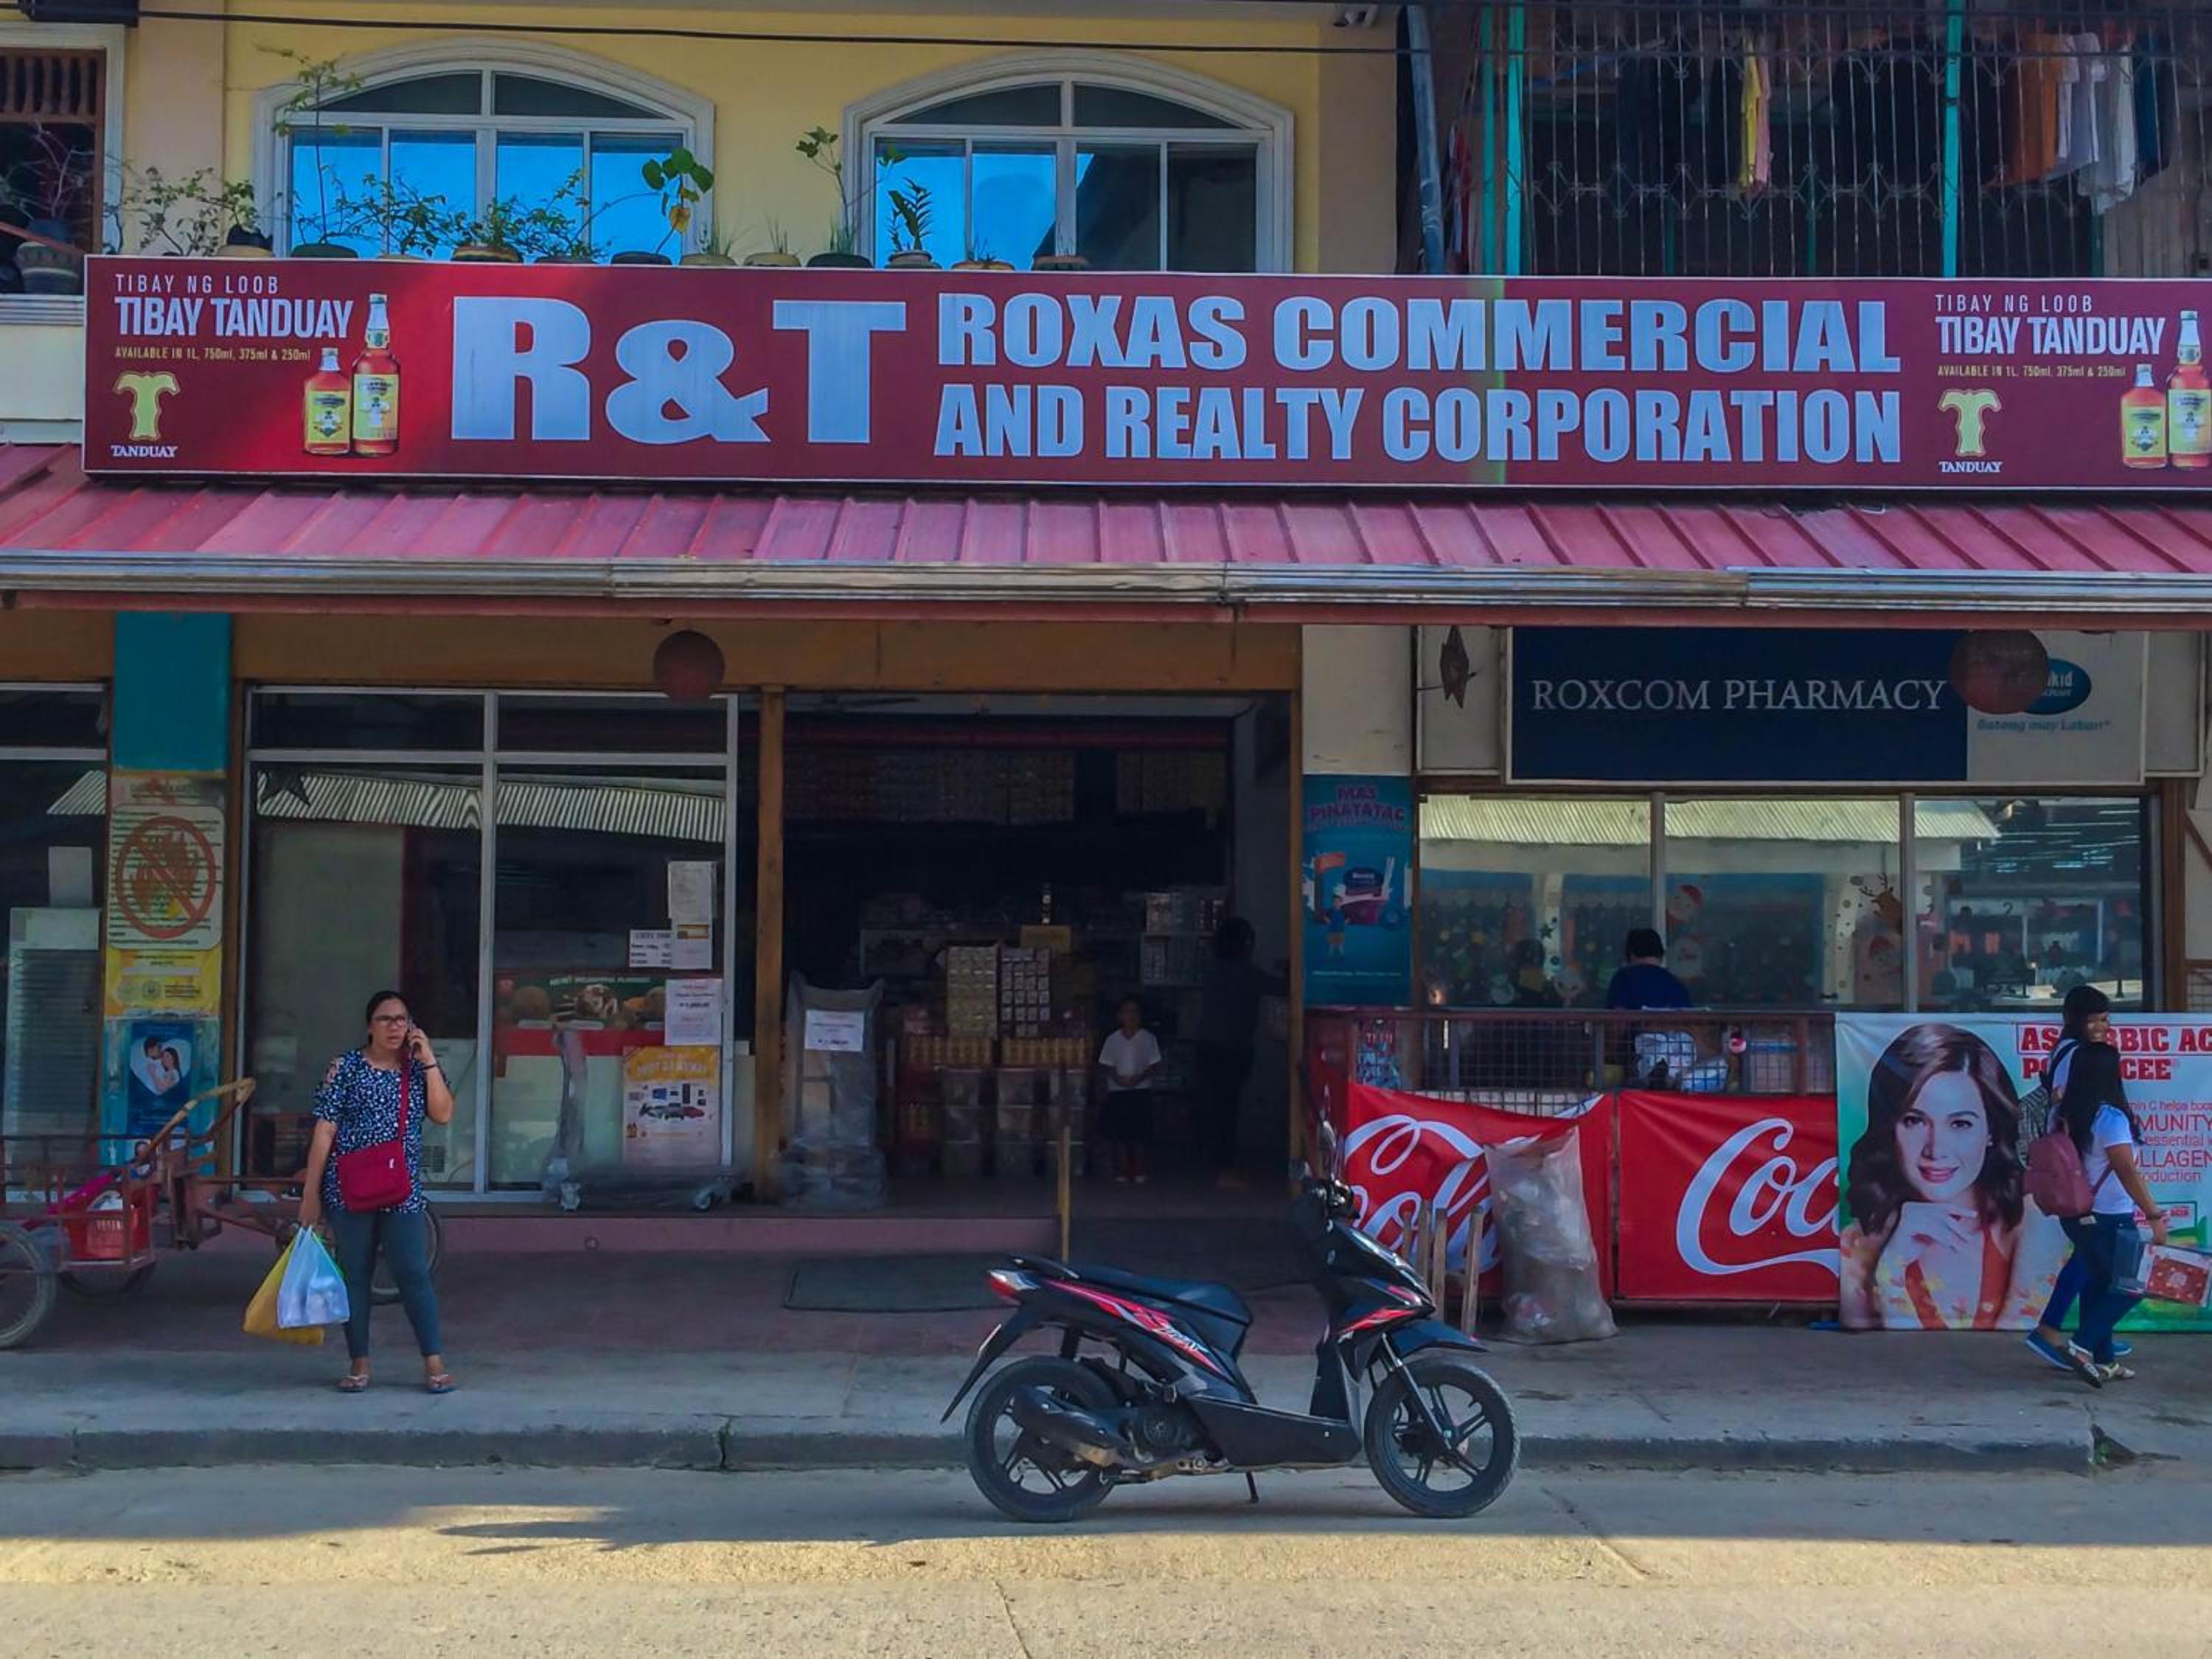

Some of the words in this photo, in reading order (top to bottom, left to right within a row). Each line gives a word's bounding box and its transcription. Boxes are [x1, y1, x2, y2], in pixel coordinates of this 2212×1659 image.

[115, 274, 175, 293] TIBAY
[187, 275, 213, 294] NG
[225, 275, 279, 294] LOOB
[1935, 294, 1992, 313] TIBAY
[2005, 295, 2029, 313] NG
[2042, 295, 2093, 313] LOOB
[114, 296, 203, 337] TIBAY
[211, 297, 354, 338] TANDUAY
[939, 293, 1247, 370] ROXAS
[1273, 295, 1902, 374] COMMERCIAL
[1935, 316, 2020, 354] TIBAY
[2027, 316, 2166, 355] TANDUAY
[115, 347, 168, 359] AVAILABLE
[172, 347, 183, 359] IN
[271, 349, 279, 361] &
[451, 296, 906, 445] R&T
[1937, 365, 1988, 378] AVAILABLE
[1992, 365, 2003, 378] IN
[933, 383, 1084, 457] AND
[1105, 385, 1364, 461] REALTY
[1382, 386, 1902, 464] CORPORATION
[111, 445, 178, 459] TANDUAY
[1938, 462, 2003, 473] TANDUAY
[1532, 679, 1711, 710] ROXCOM
[1723, 679, 1947, 710] PHARMACY
